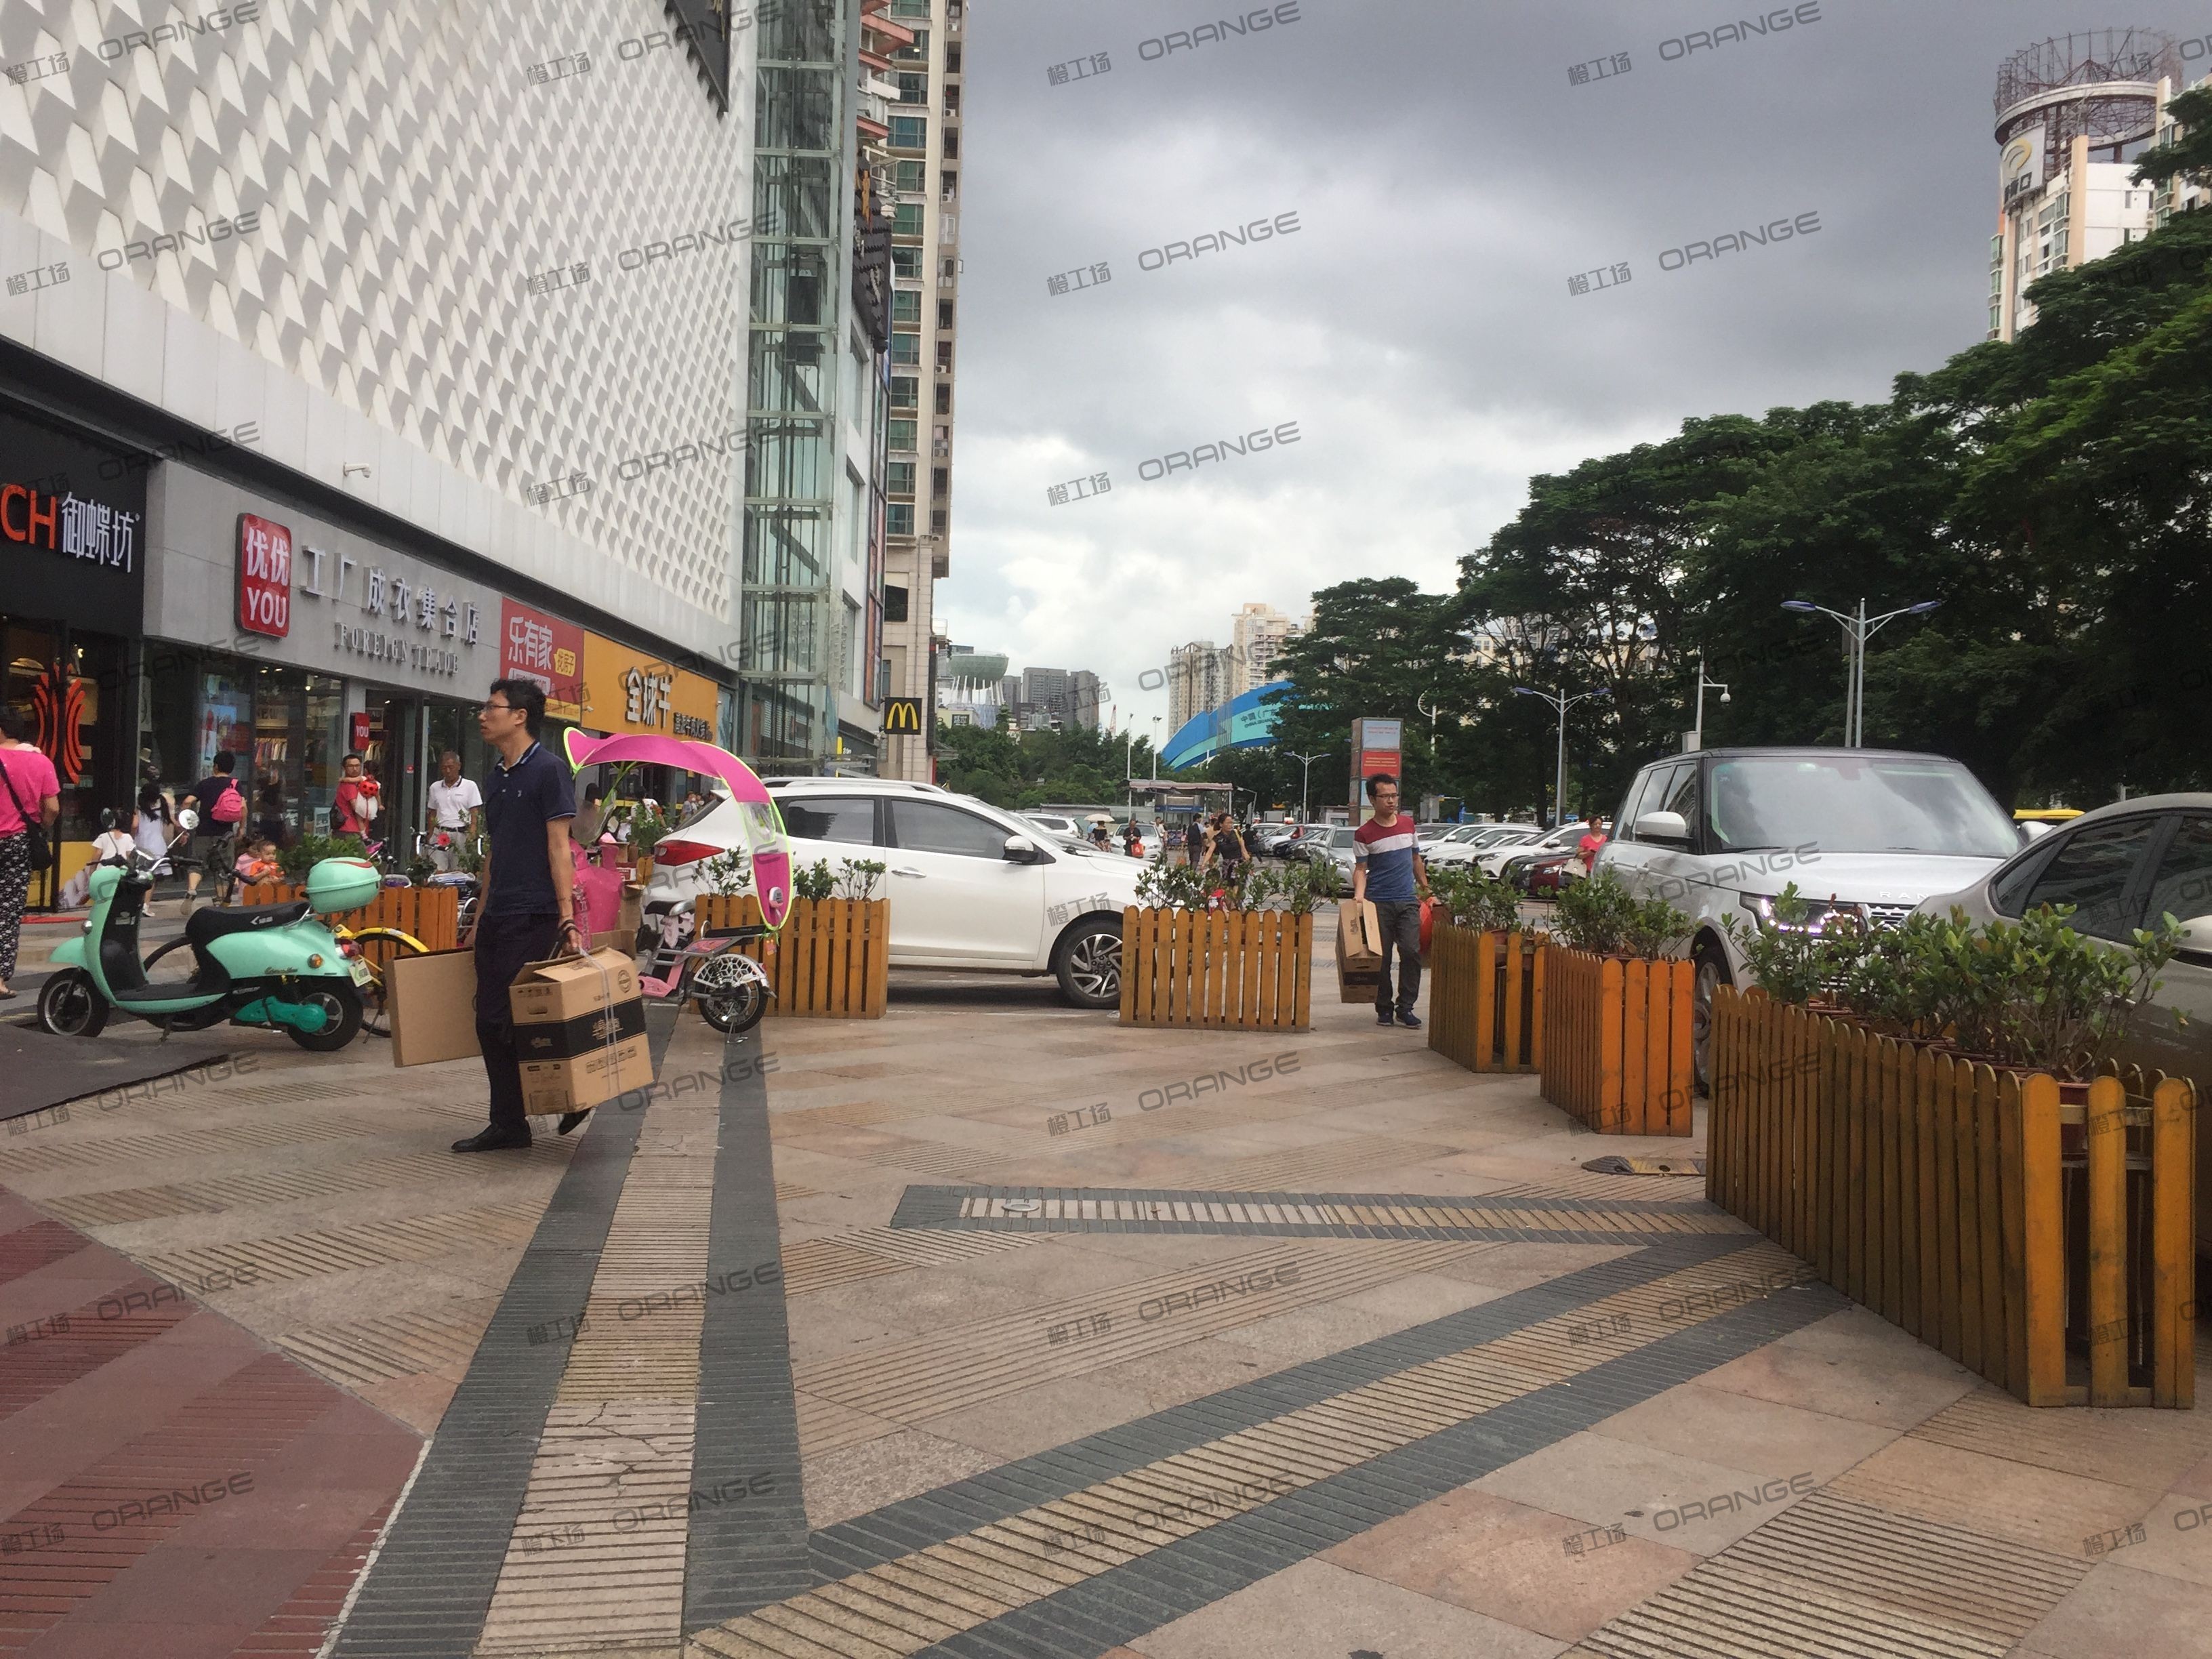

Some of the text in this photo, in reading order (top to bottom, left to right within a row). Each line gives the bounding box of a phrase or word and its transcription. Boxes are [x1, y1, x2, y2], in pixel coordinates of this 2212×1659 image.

[1, 483, 135, 573] CH 御蝶坊
[246, 528, 289, 586] 优优
[247, 587, 287, 628] YOU
[303, 545, 480, 645] 工厂成衣集合店
[337, 622, 459, 673] FOREIGN TRADE
[508, 616, 554, 671] 乐有家
[626, 667, 672, 729] 全球牛
[356, 725, 369, 738] YOU
